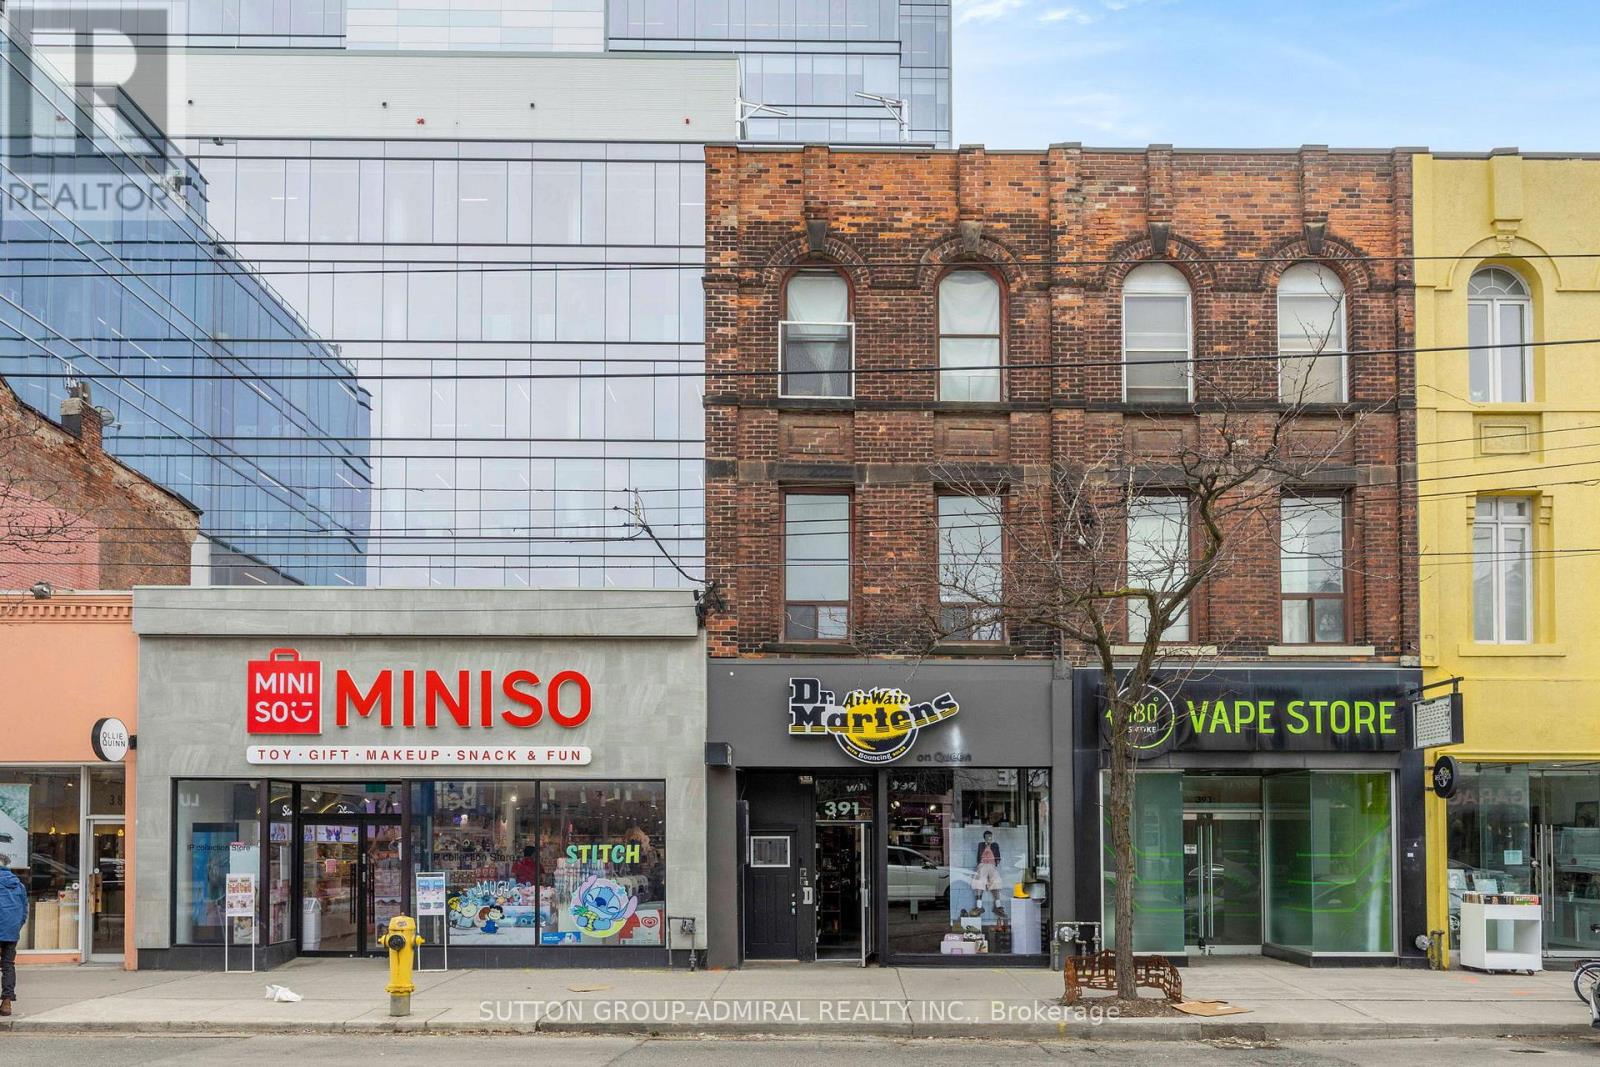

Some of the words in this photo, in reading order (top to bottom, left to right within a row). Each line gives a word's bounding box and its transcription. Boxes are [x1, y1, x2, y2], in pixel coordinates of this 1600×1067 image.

[255, 672, 313, 694] MINI
[336, 668, 593, 729] MINISO
[844, 688, 908, 709] AirWair
[789, 692, 960, 734] Martens
[1186, 701, 1275, 734] VAPE
[1286, 700, 1397, 734] STORE
[102, 731, 124, 740] OLLIE
[102, 740, 126, 748] QUINN
[257, 750, 292, 761] TOY
[309, 750, 349, 761] GIFT
[366, 750, 440, 761] MAKEUP
[456, 750, 517, 761] SNACK
[527, 750, 536, 761] &
[547, 750, 581, 761] FUN
[858, 752, 893, 761] Bouncing
[917, 753, 932, 762] on
[934, 752, 972, 763] Queen
[824, 801, 860, 816] 391
[566, 844, 640, 864] STITCH
